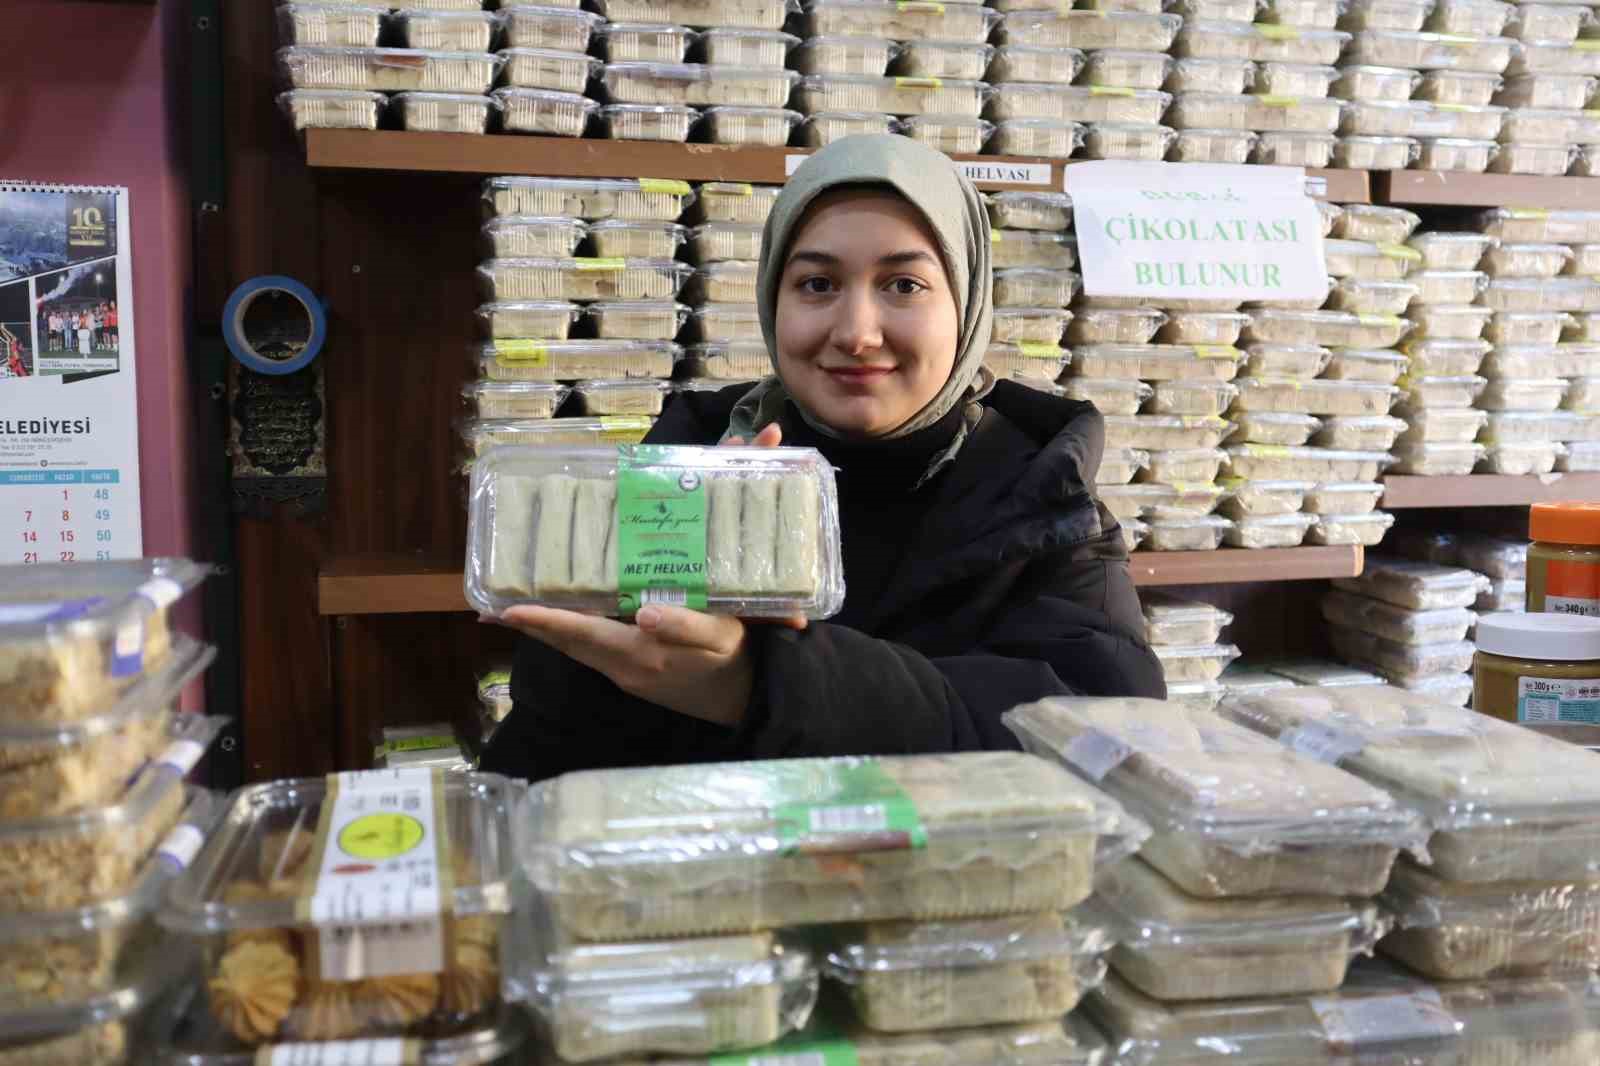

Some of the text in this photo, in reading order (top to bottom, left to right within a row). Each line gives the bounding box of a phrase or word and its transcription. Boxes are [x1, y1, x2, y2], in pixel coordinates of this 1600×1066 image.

[964, 166, 1031, 181] HELVASI
[72, 207, 101, 227] 10
[1104, 212, 1300, 245] ÇİKOLATASI
[1135, 261, 1282, 288] BULUNUR
[62, 488, 109, 501] 1 48
[24, 510, 111, 522] 7 8 49
[23, 529, 111, 543] 14 15 50
[24, 550, 111, 564] 21 22 51
[624, 561, 703, 575] MET HELVASI
